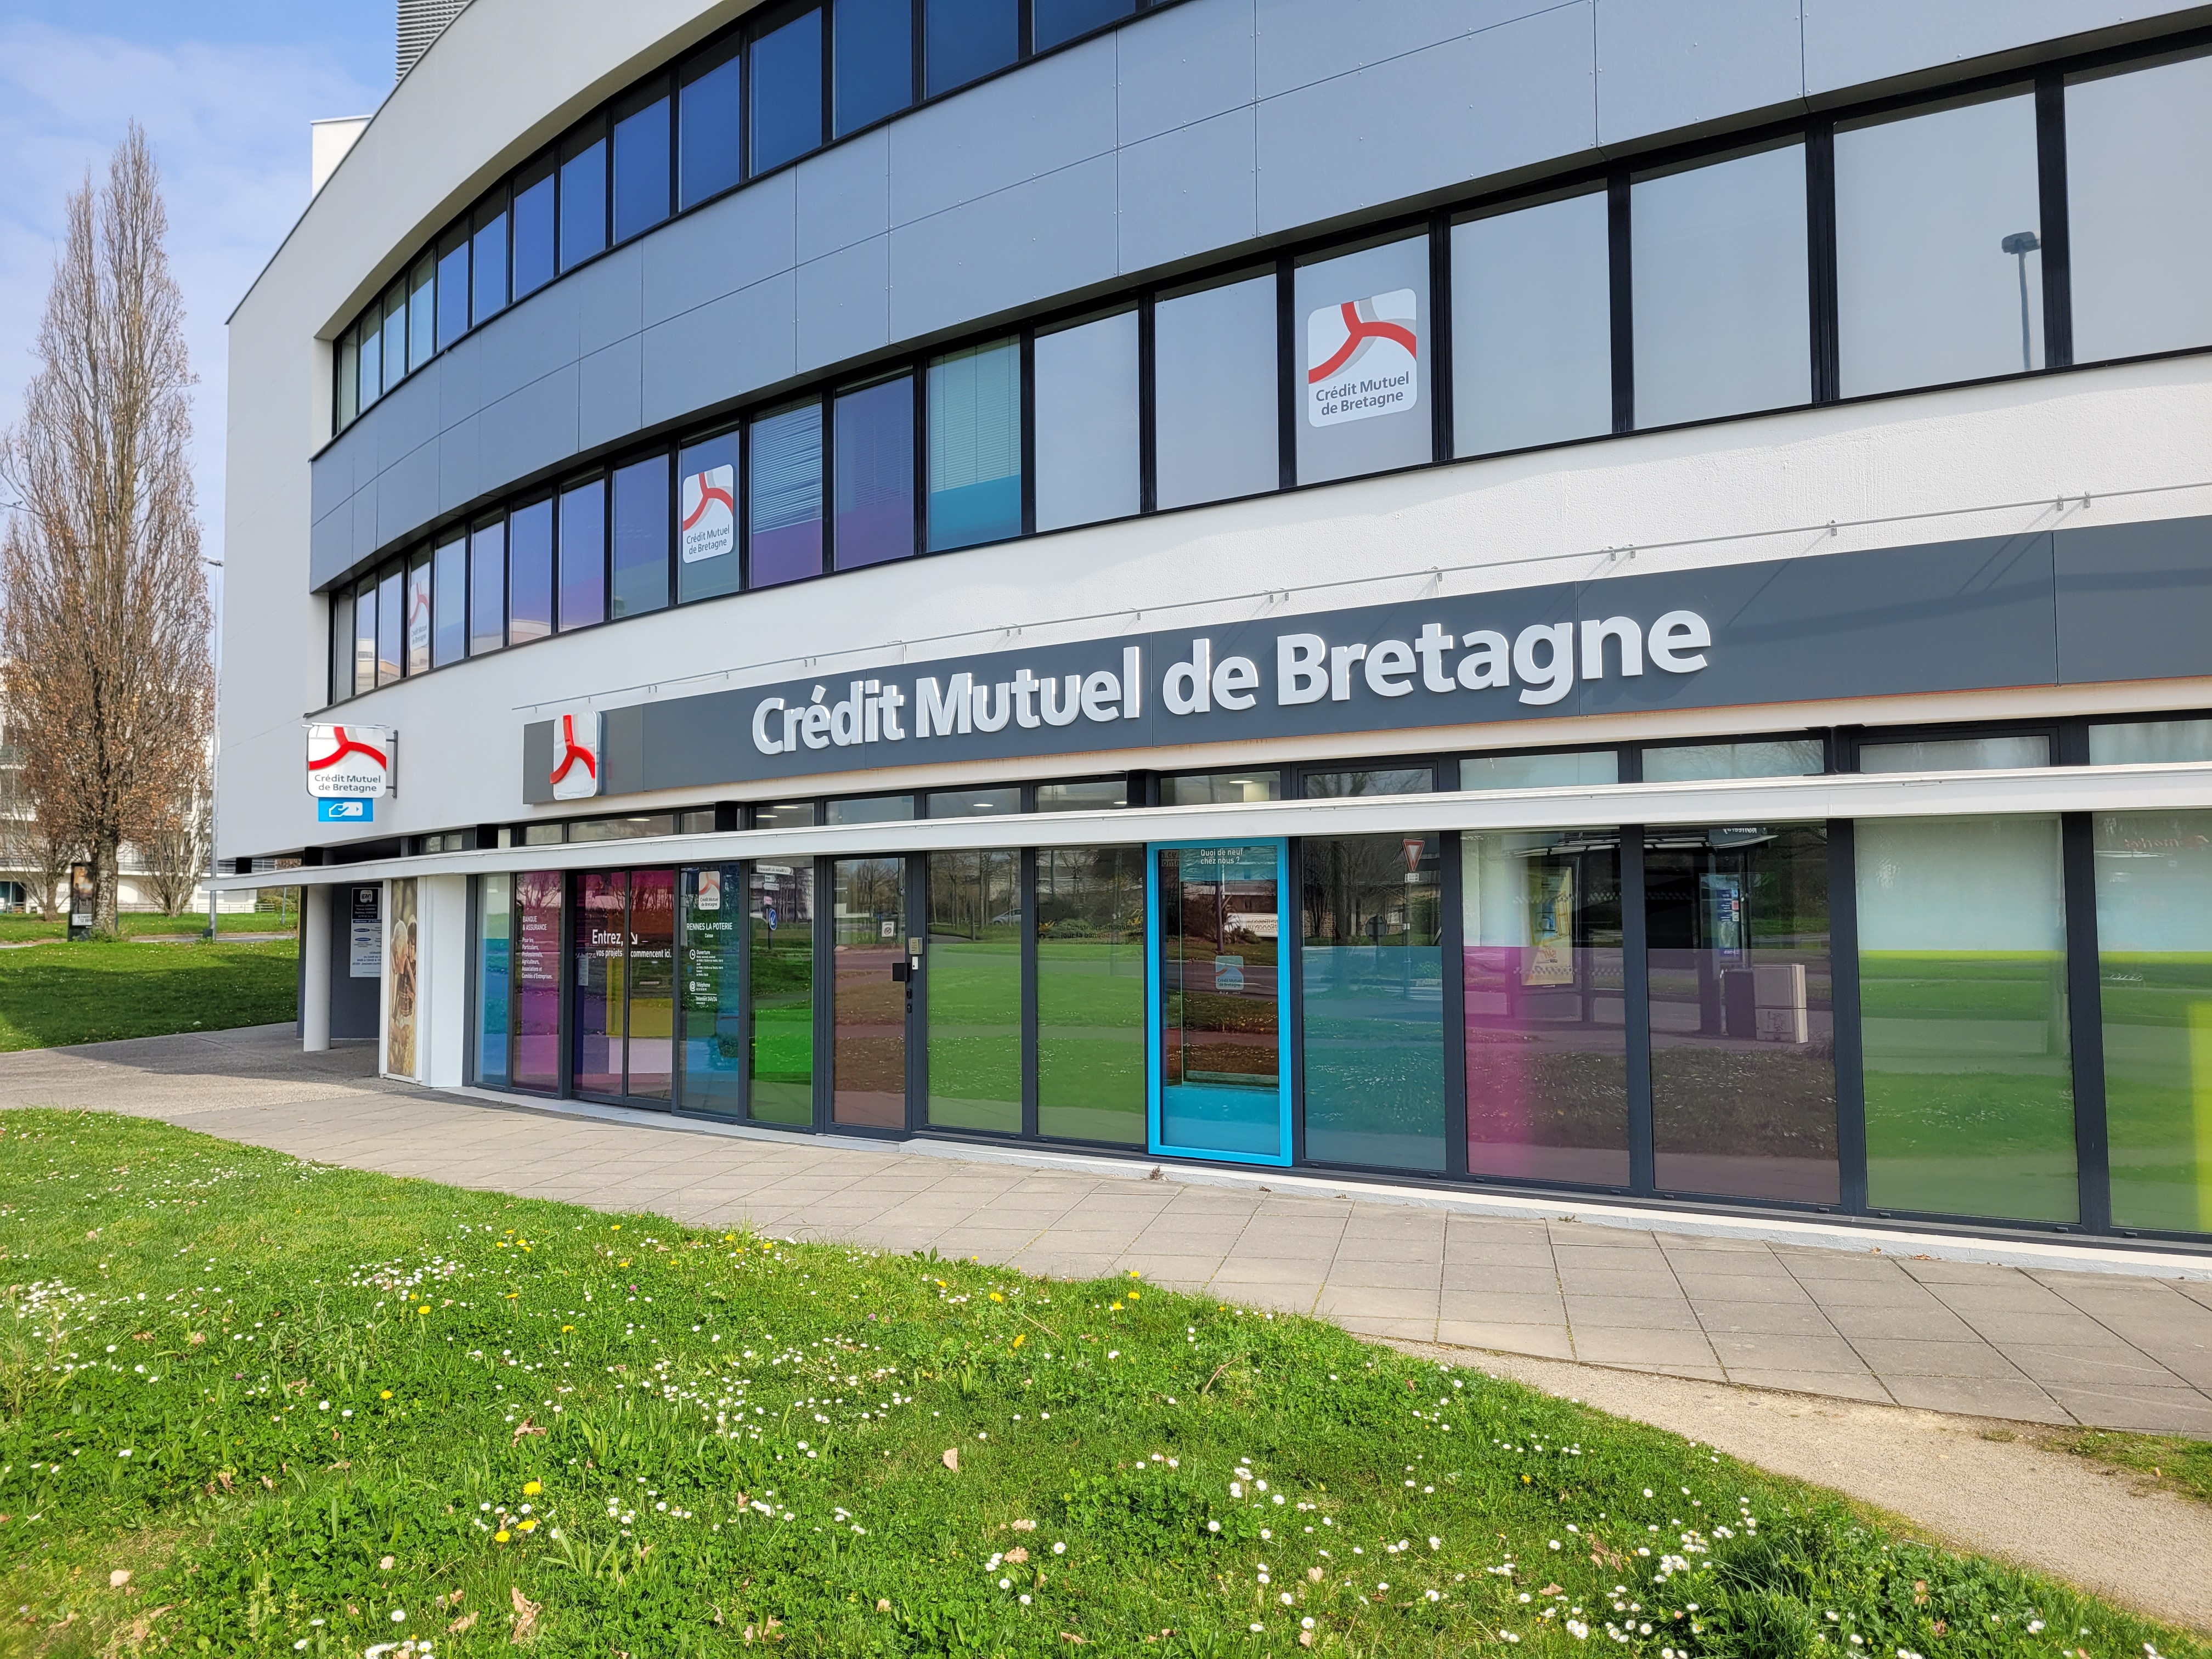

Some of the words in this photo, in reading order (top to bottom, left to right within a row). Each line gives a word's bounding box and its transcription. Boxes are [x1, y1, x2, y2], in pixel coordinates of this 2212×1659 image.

[1316, 382, 1357, 402] Crédit
[1360, 371, 1409, 393] Mutuel
[1321, 402, 1338, 416] de
[1341, 391, 1404, 412] Bretagne
[686, 532, 706, 544] Crédit
[707, 524, 730, 540] Mutuel
[689, 544, 697, 555] de
[698, 539, 727, 552] Bretagne
[752, 679, 905, 755] Crédit
[915, 645, 1141, 739] Mutuel
[1162, 637, 1259, 715] de
[1277, 610, 1712, 706] Bretagne
[314, 774, 345, 782] Crédit
[332, 783, 377, 793] Bretagne
[1217, 848, 1226, 856] de
[1227, 848, 1244, 856] neuf
[1235, 856, 1240, 864] ?
[592, 929, 623, 947] Entrez,
[605, 949, 623, 959] projets
[630, 949, 664, 958] commencent
